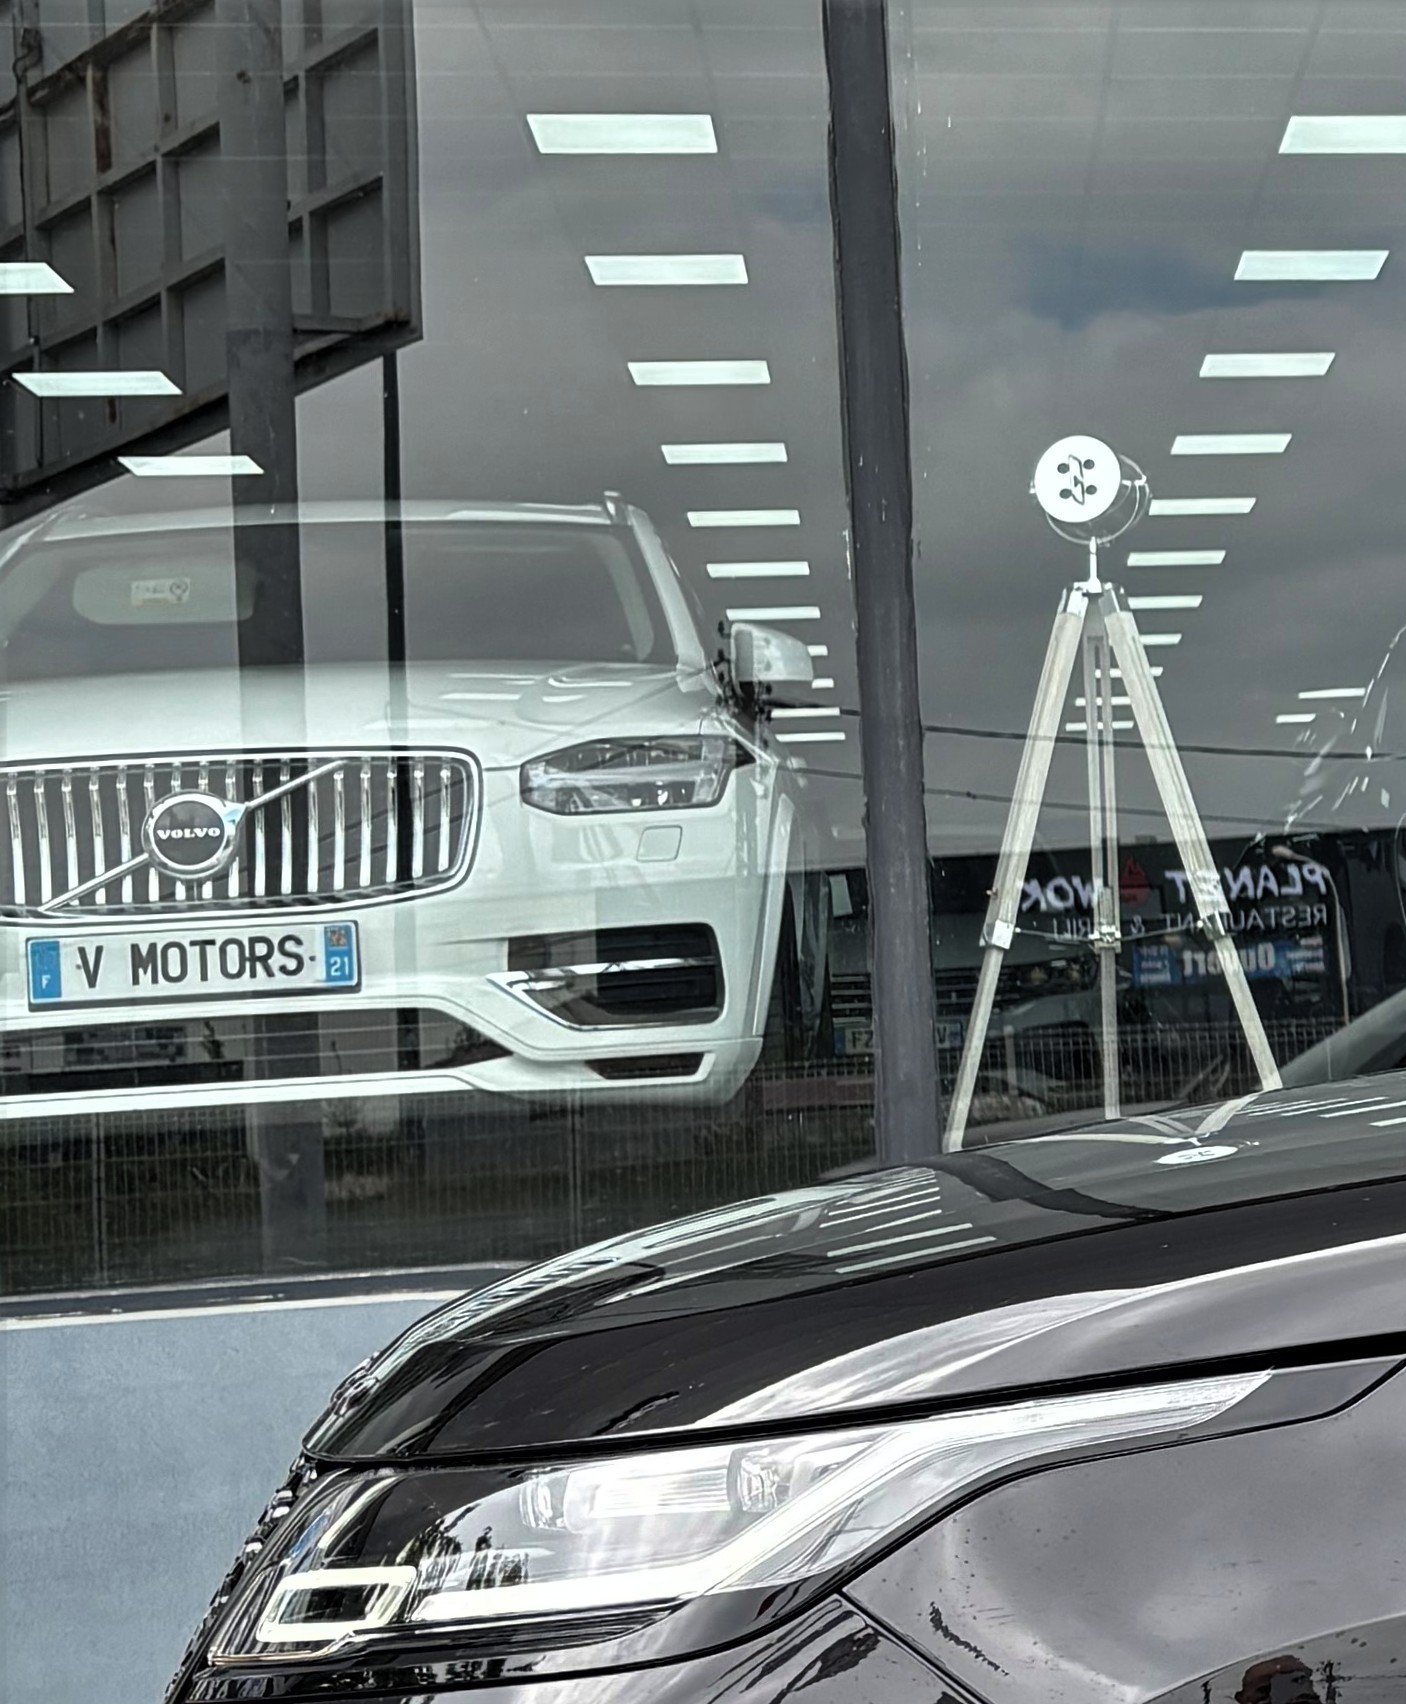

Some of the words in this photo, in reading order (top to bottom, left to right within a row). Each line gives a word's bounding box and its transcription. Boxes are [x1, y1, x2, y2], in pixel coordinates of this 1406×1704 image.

[156, 826, 221, 840] VOLVO
[77, 944, 104, 989] V
[130, 934, 305, 987] MOTORS
[330, 956, 349, 977] 21
